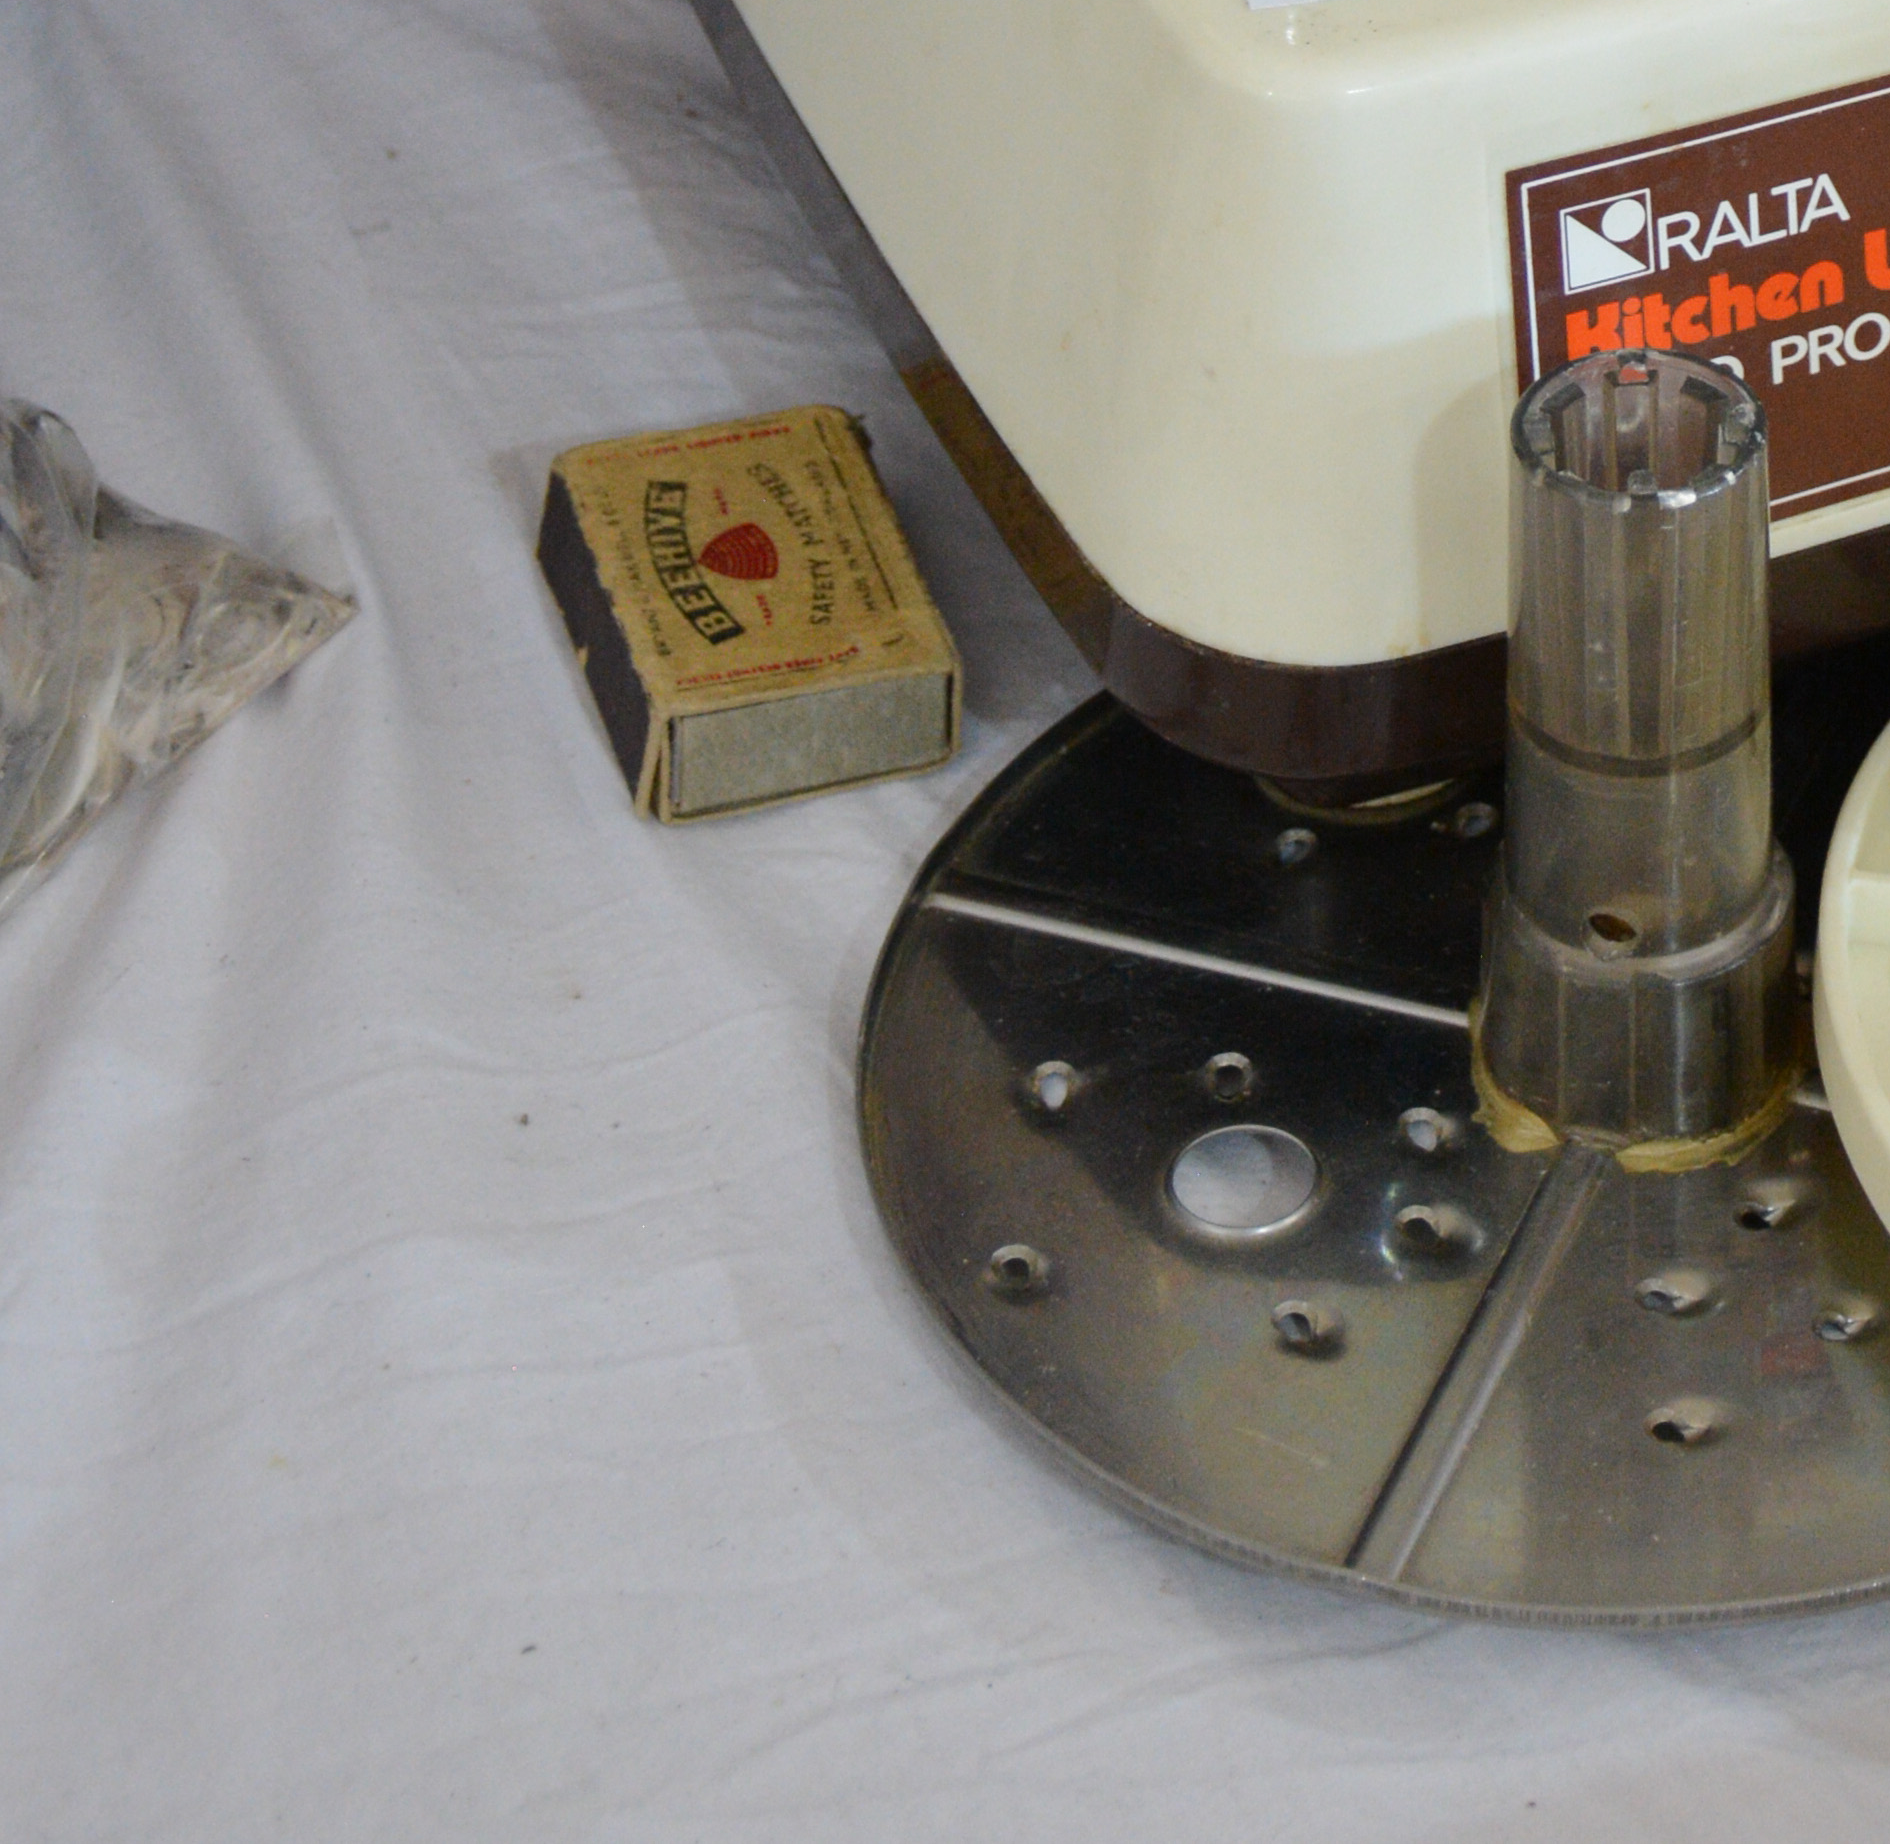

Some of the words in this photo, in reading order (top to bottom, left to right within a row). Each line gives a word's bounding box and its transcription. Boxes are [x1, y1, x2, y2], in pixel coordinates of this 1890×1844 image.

[1657, 173, 1850, 271] RALTA
[1565, 259, 1845, 361] Kitchen
[646, 479, 742, 643] BEEHIVE
[809, 558, 836, 627] SAFETY
